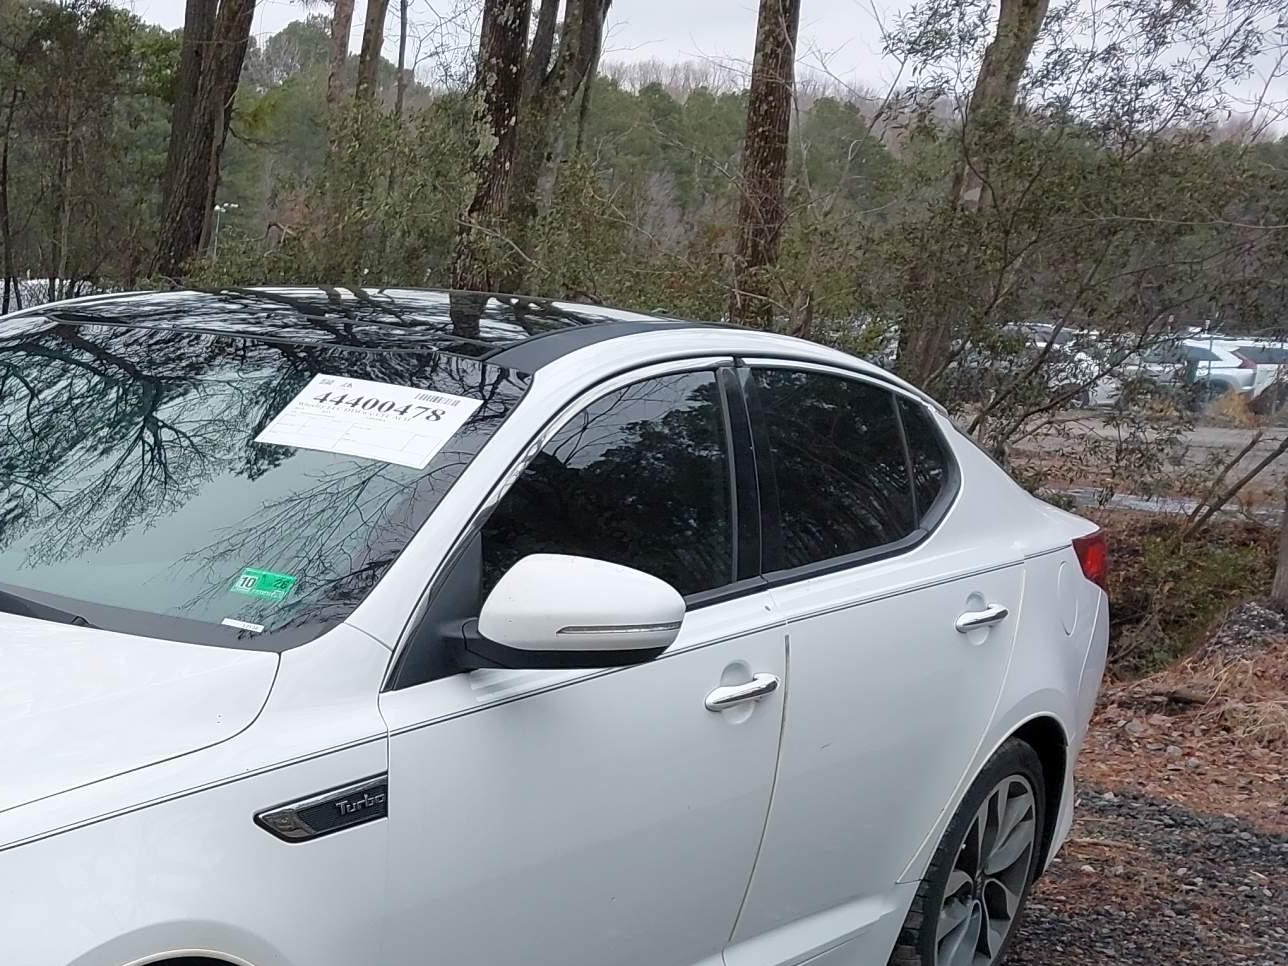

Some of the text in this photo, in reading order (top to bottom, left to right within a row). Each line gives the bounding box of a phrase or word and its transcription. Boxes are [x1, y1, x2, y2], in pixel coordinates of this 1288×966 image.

[313, 391, 446, 422] 44400478
[240, 576, 289, 590] 10 26
[336, 793, 385, 815] Turbo
